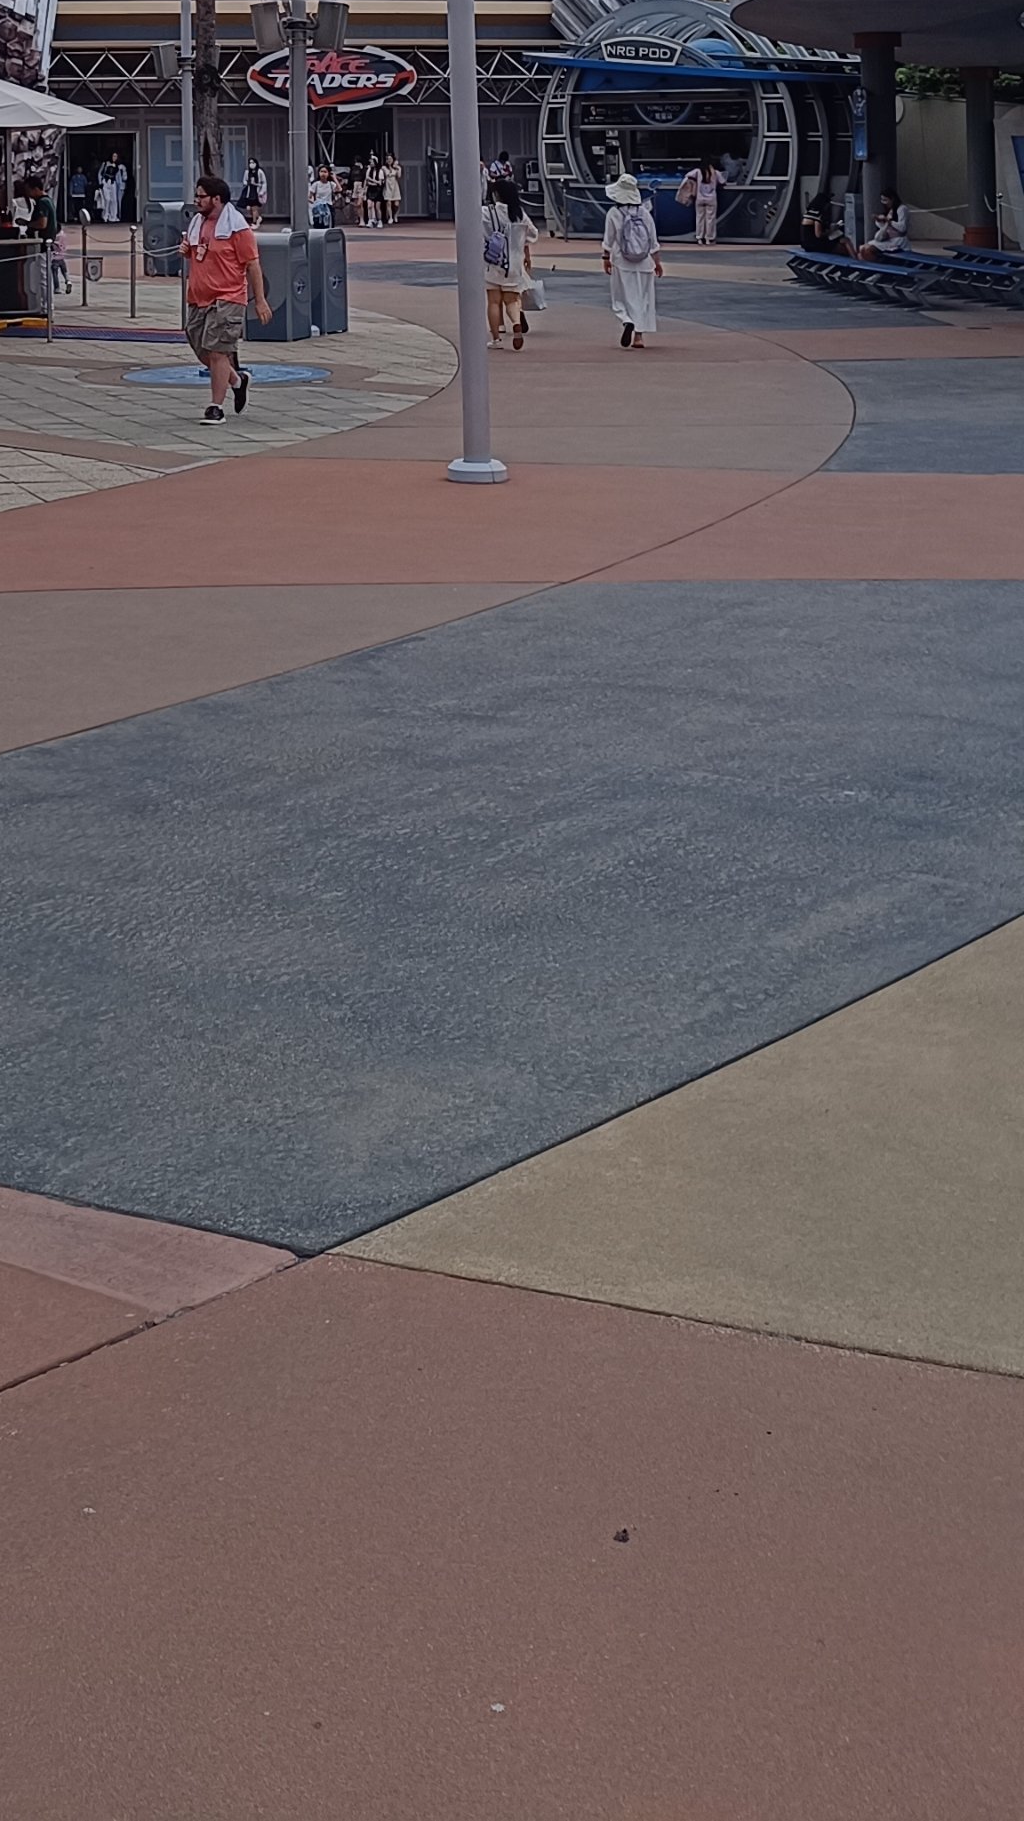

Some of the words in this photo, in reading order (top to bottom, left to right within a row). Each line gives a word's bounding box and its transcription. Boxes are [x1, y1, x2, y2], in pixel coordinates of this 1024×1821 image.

[273, 52, 374, 73] PACE
[606, 45, 636, 57] NRG
[638, 47, 671, 59] POD
[267, 73, 397, 95] TADERS
